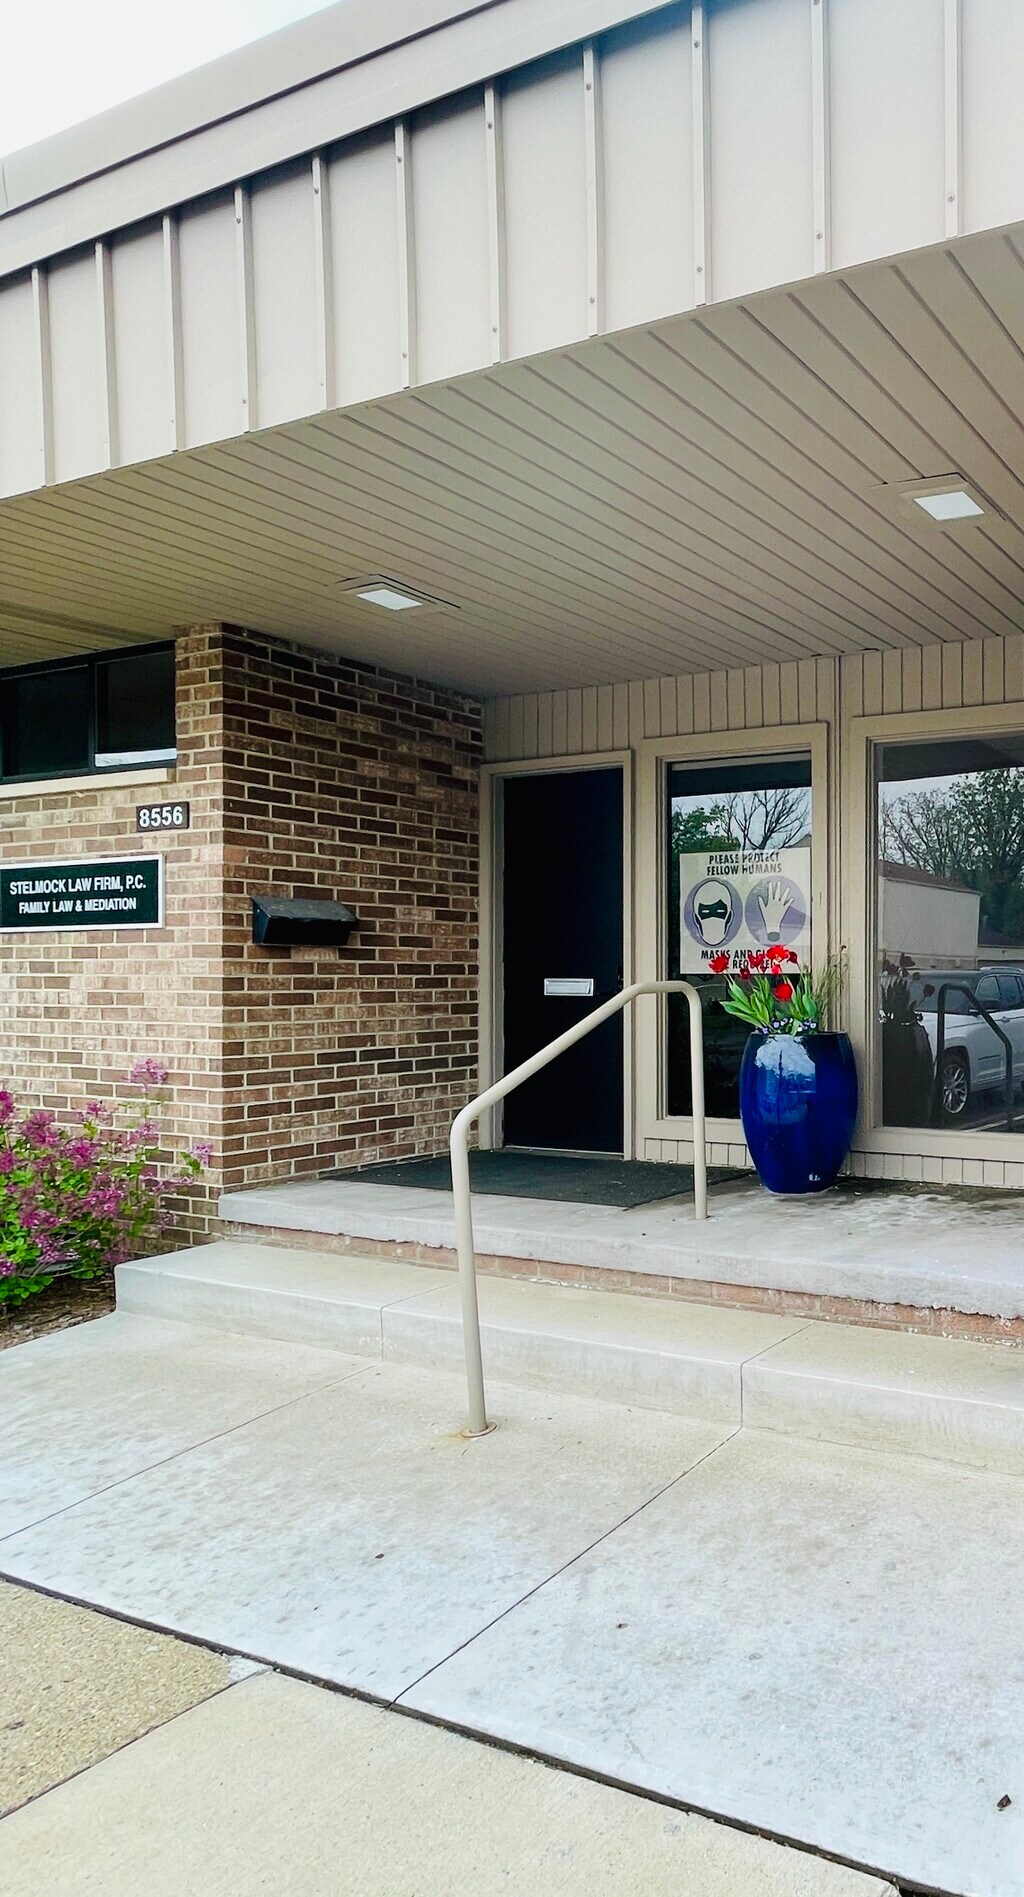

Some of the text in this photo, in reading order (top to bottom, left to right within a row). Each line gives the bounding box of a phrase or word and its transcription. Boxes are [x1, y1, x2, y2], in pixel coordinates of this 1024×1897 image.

[139, 805, 183, 828] 8556
[709, 851, 779, 864] PLEASE PROTECT
[707, 863, 782, 876] FELLOW HUMANS
[9, 875, 147, 895] STELMOCK LAW FIRM, P.C.
[19, 897, 137, 914] FAMILY LAW & MEDIATION
